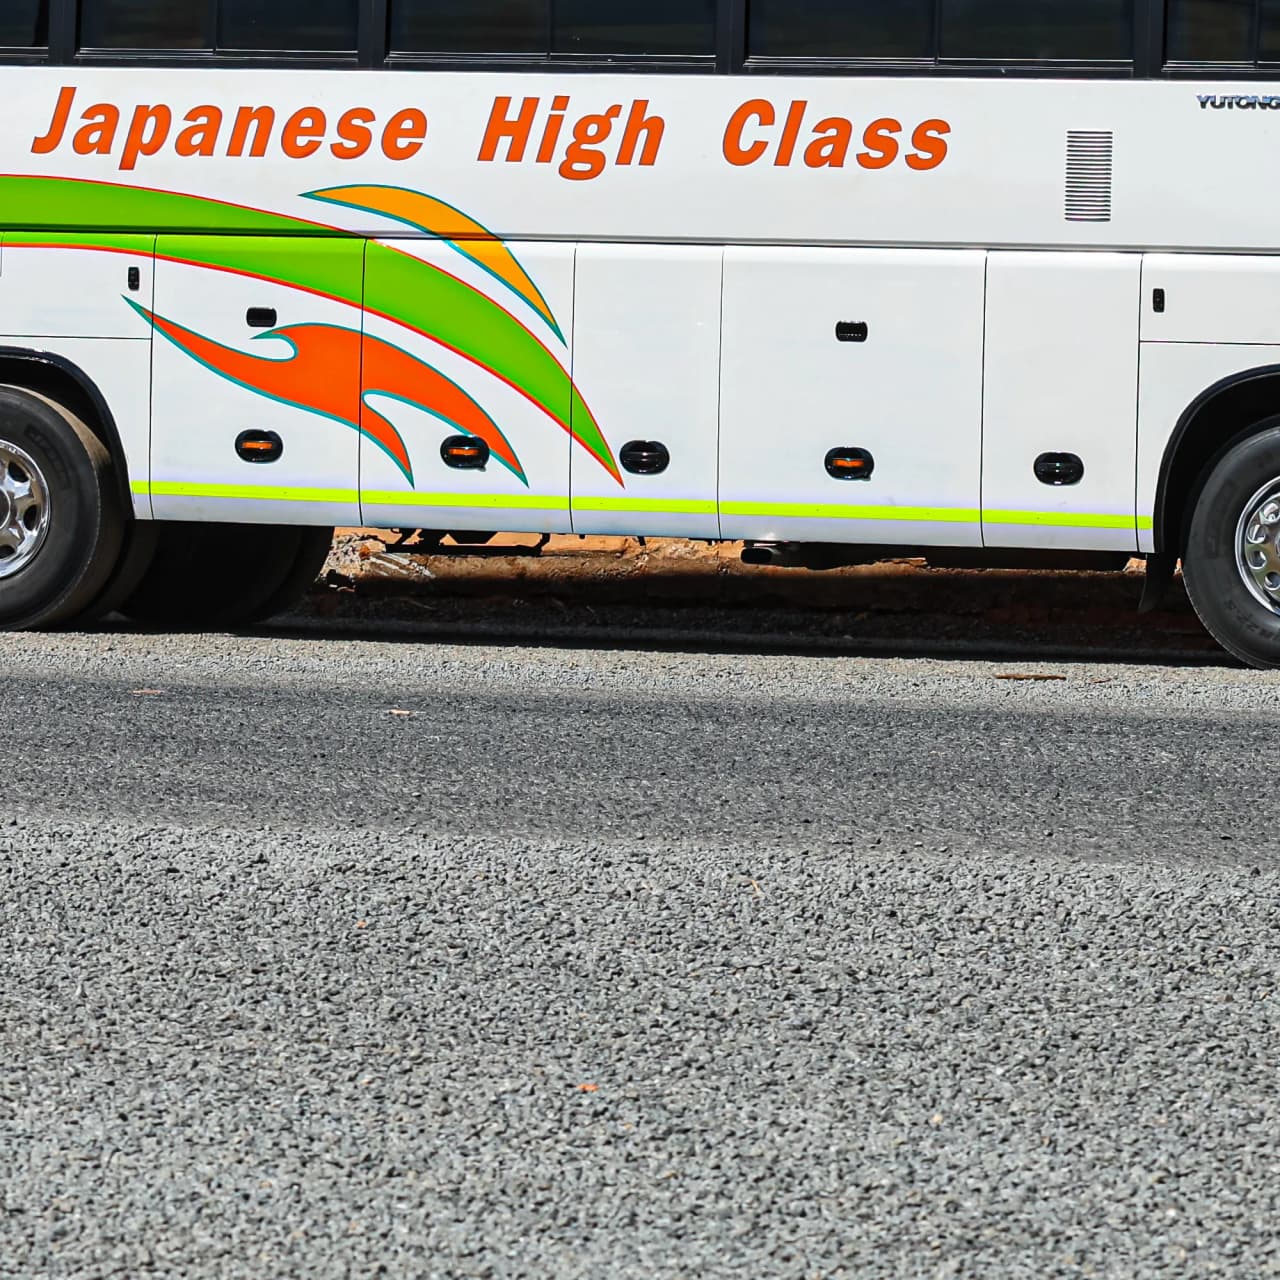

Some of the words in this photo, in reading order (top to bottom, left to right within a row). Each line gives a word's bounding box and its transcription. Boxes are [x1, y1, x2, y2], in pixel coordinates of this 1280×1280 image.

[31, 86, 428, 171] Japanese
[477, 96, 666, 181] High
[722, 98, 952, 171] Class
